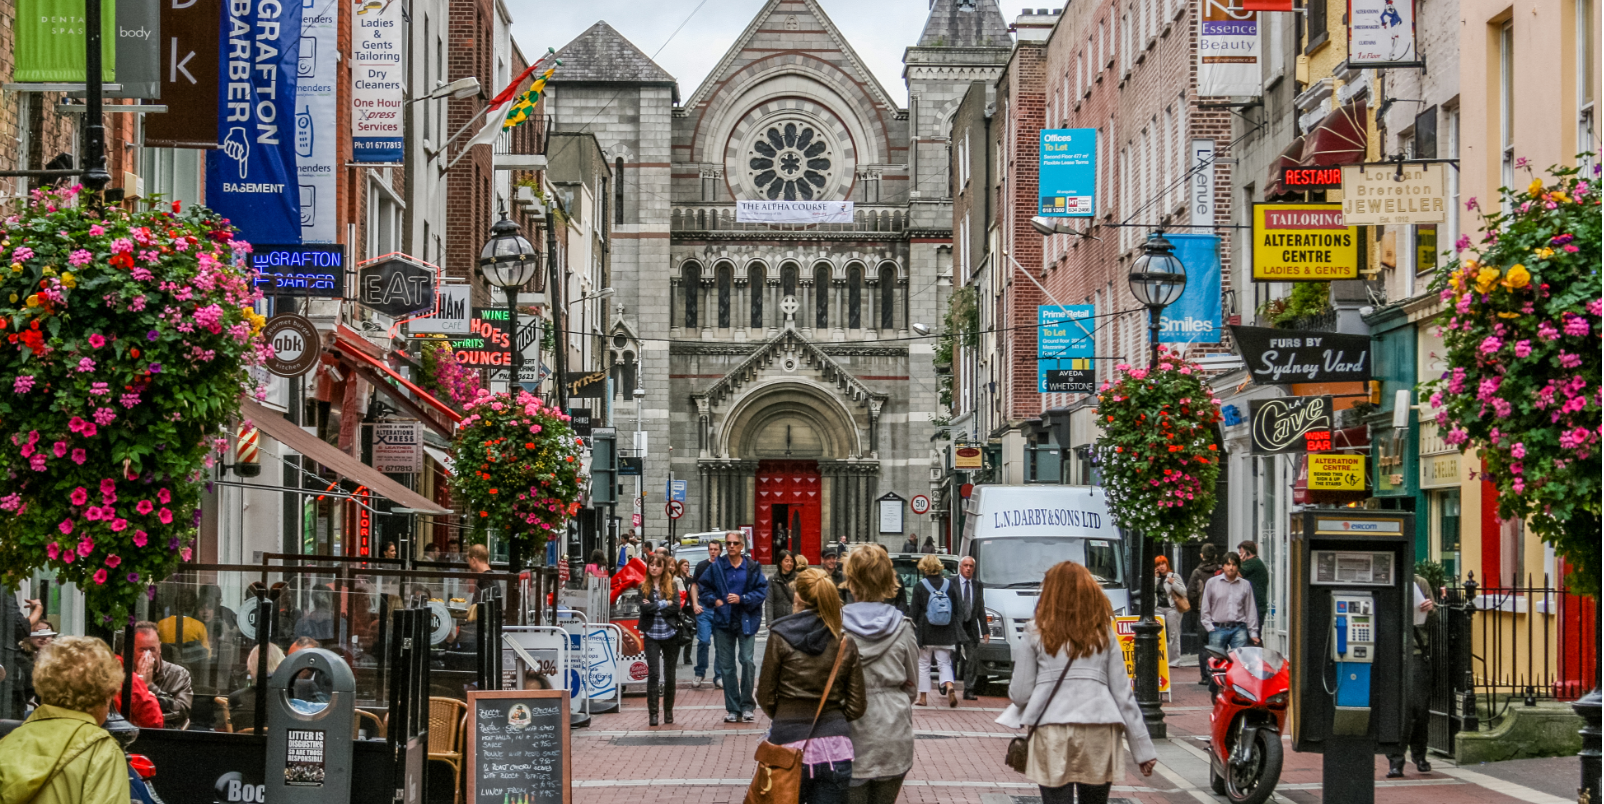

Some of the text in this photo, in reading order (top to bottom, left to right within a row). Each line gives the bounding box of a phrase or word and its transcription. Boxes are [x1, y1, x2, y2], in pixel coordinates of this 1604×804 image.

[303, 15, 333, 24] enders
[361, 19, 394, 28] Ladies
[52, 27, 84, 35] SPAS
[119, 26, 151, 40] body
[1202, 22, 1256, 34] Essence
[373, 30, 382, 38] &
[362, 41, 393, 49] Gents
[1200, 39, 1255, 52] Beauty
[227, 0, 250, 122] BARBER
[354, 52, 400, 62] Tailoring
[255, 0, 282, 145] GRAFTON
[368, 69, 387, 80] Dry
[355, 80, 400, 89] Cleaners
[353, 99, 401, 107] One Hour
[358, 109, 397, 121] Xpress
[358, 122, 398, 131] Services
[1044, 134, 1072, 142] Offices
[354, 141, 401, 149] Ph: 01 6717813
[1055, 143, 1068, 151] Let
[1285, 169, 1341, 185] RESTAUR
[1365, 170, 1422, 181] Loran
[223, 182, 285, 194] BASEMENT
[1357, 185, 1431, 196] Brereton
[1344, 197, 1443, 214] JEWELLER
[1271, 213, 1343, 226] TAILORING
[1264, 234, 1351, 247] ALTERATIONS
[270, 251, 341, 267] GRAFTON
[1282, 250, 1331, 263] CENTRE
[1264, 266, 1350, 275] LADIES & GENTS
[365, 271, 428, 306] EAT
[266, 320, 292, 336] gourmet
[293, 320, 311, 336] burger
[1159, 316, 1213, 332] Smiles
[274, 335, 302, 353] gbk
[452, 338, 484, 348] SPIRITS
[1270, 338, 1322, 348] FURS BY
[275, 362, 301, 370] kitchen
[1254, 349, 1366, 380] Sydney Vard
[1049, 382, 1093, 391] WHETSTONE
[1288, 398, 1303, 409] LA
[1253, 398, 1329, 451] Cave
[1305, 431, 1331, 440] WINE
[1307, 440, 1332, 451] BAR
[915, 499, 925, 508] 50
[1081, 511, 1101, 529] LTD
[289, 731, 324, 740] LITTER IS
[288, 740, 324, 748] DISGUSTING
[481, 788, 503, 796] LUNCH
